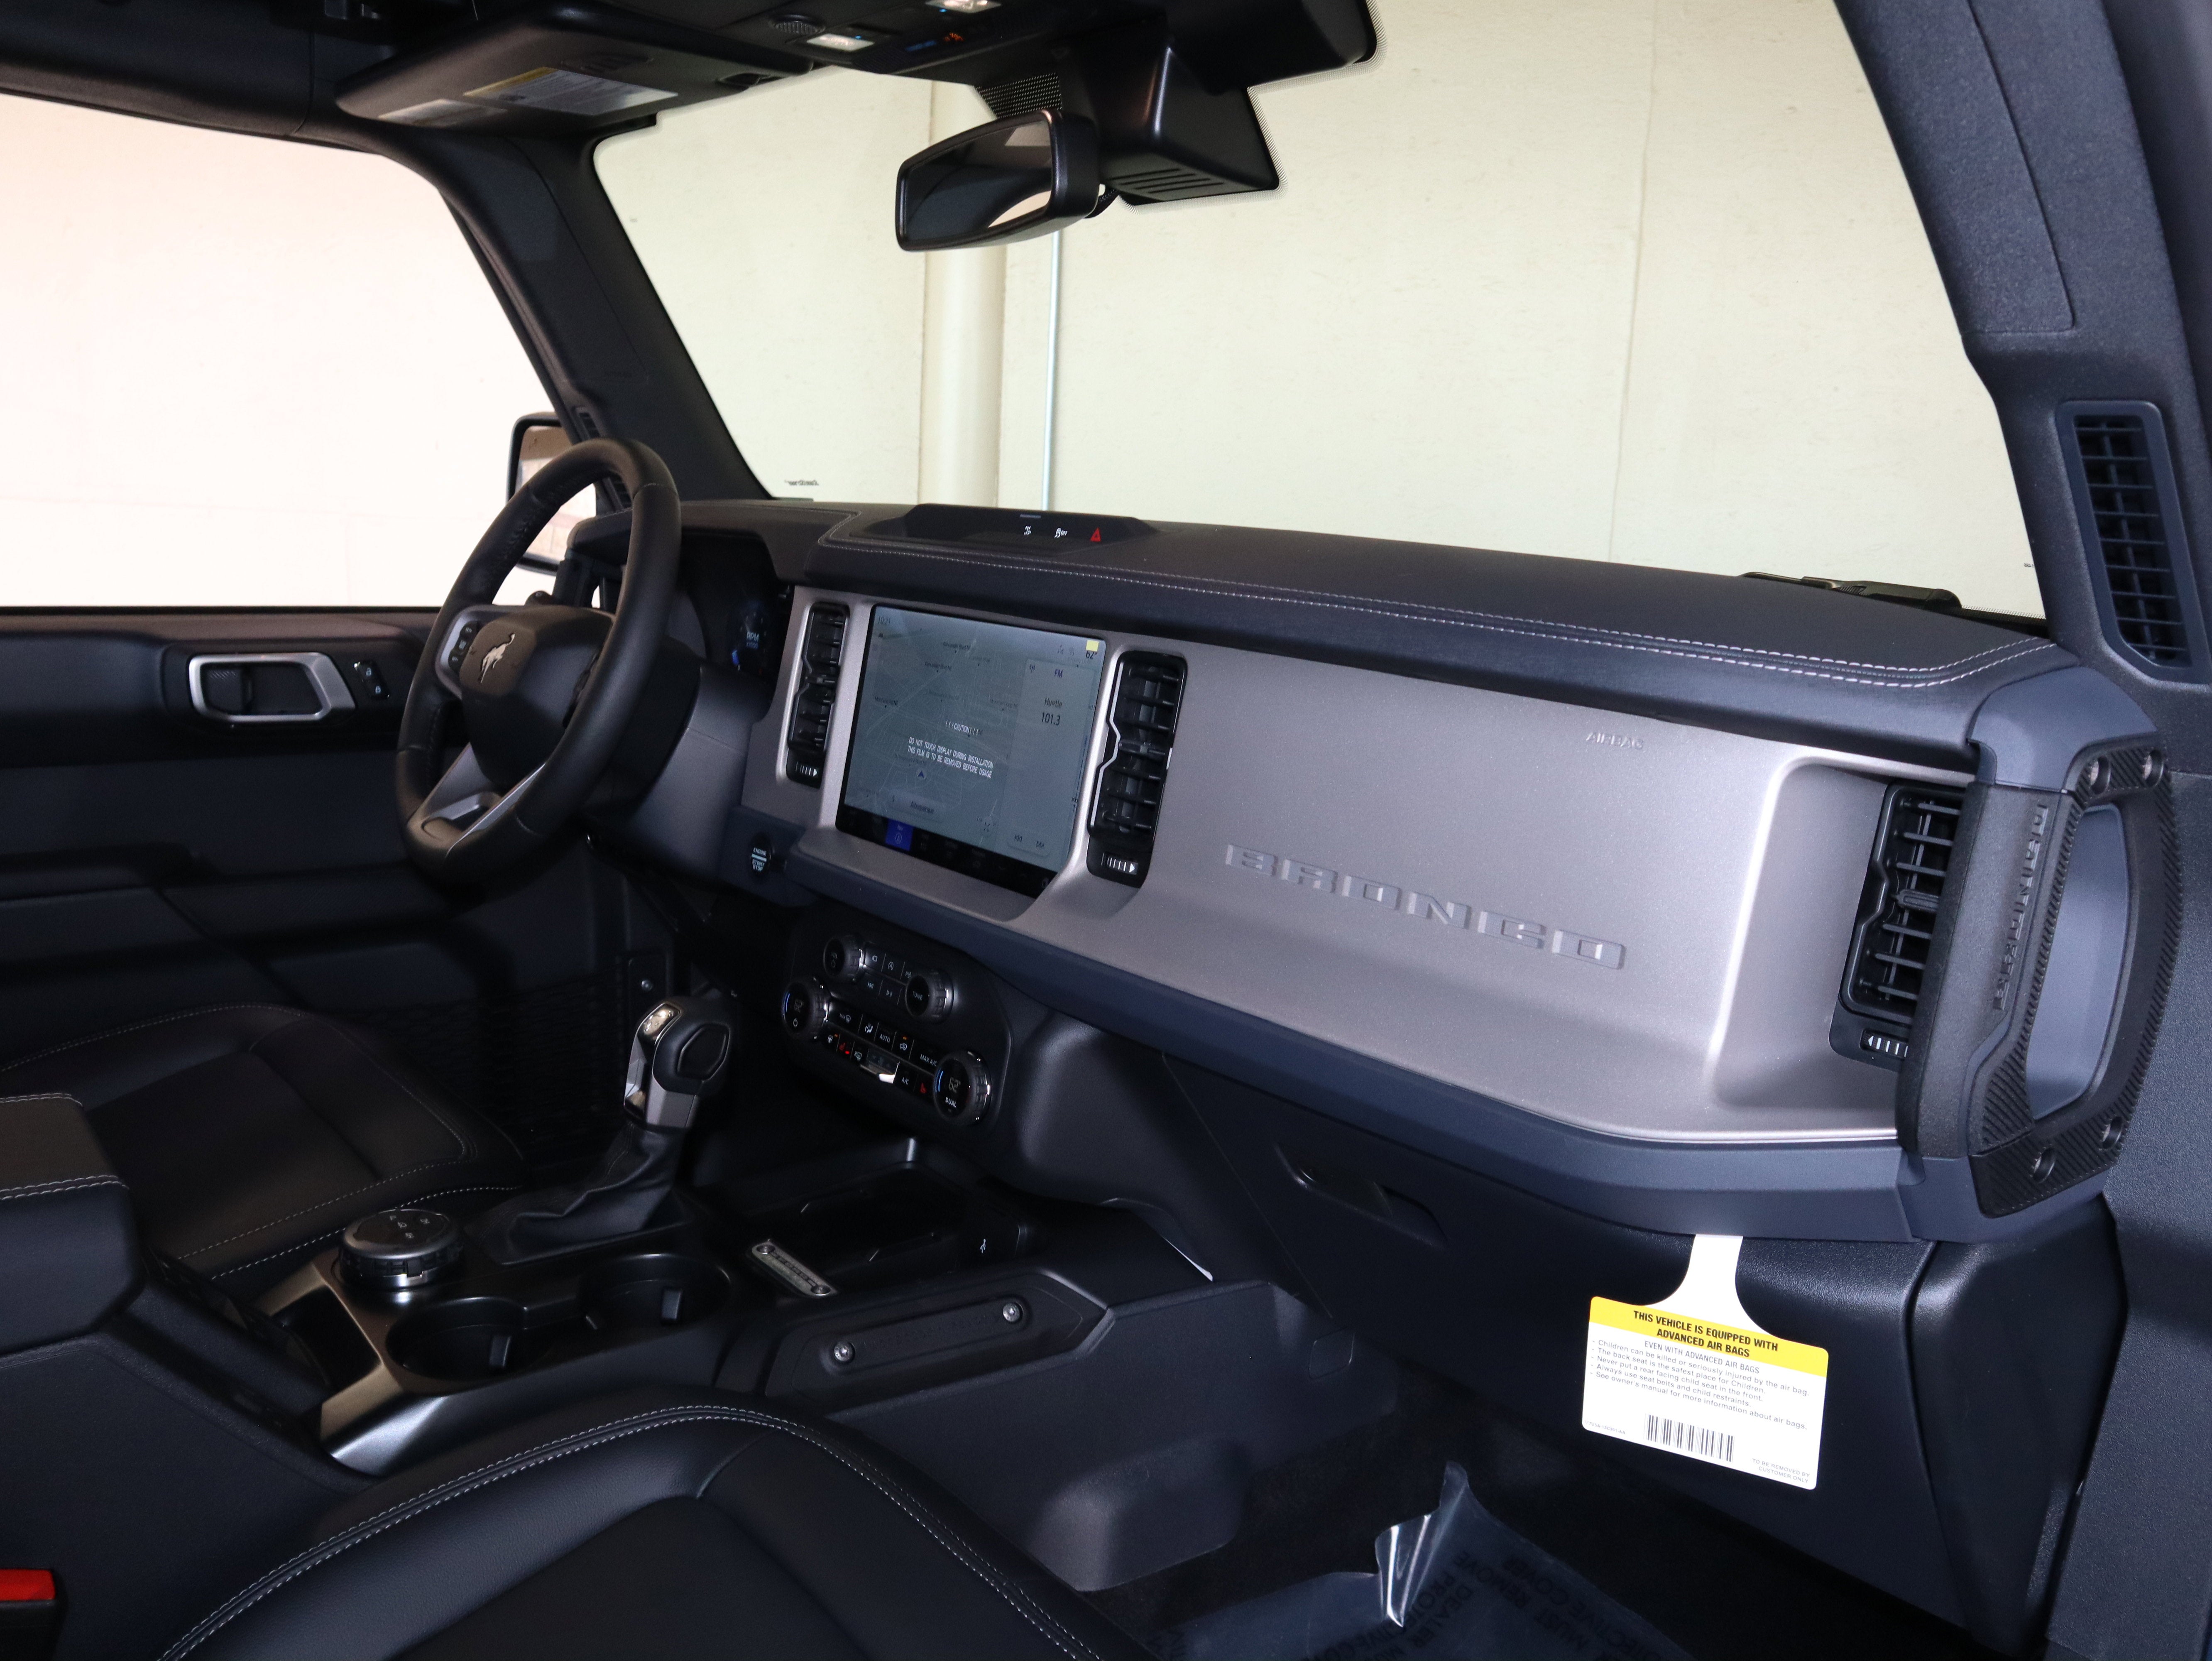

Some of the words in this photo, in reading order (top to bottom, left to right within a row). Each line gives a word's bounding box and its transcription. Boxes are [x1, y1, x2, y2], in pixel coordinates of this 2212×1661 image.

[746, 631, 760, 642] RPM
[1055, 669, 1063, 678] FM
[1041, 712, 1061, 726] 101.3
[916, 748, 925, 757] FILM
[944, 757, 962, 769] REMOVED
[963, 763, 978, 774] BEFORE
[979, 768, 992, 778] USAGE
[924, 741, 936, 751] TOUCH
[937, 745, 952, 756] DISPLAY
[953, 750, 966, 760] DURING
[968, 755, 994, 768] INSTALLATION
[1225, 844, 1626, 970] BRONCO
[912, 991, 923, 1001] TUNE
[879, 1034, 891, 1043] AUTO
[920, 1053, 930, 1063] MAX
[945, 1097, 957, 1108] DUAL
[1634, 1311, 1653, 1322] THIS
[1656, 1316, 1691, 1331] VEHICLE
[1695, 1325, 1703, 1334] IS
[1706, 1328, 1750, 1345] EQUIPPED
[1754, 1338, 1778, 1351] WITH
[1657, 1329, 1704, 1346] ADVANCED
[1707, 1340, 1722, 1350] AIR
[1725, 1345, 1749, 1357] BAGS
[1598, 1340, 1628, 1352] Children
[1657, 1354, 1676, 1364] killed
[1688, 1362, 1723, 1376] seriously
[1725, 1370, 1752, 1382] injured
[1754, 1377, 1764, 1386] by
[1766, 1380, 1778, 1388] the
[1792, 1386, 1809, 1396] bag.
[1598, 1347, 1611, 1356] The
[1613, 1351, 1630, 1361] back
[1671, 1367, 1694, 1376] safest
[1696, 1372, 1716, 1382] place
[1731, 1380, 1765, 1394] Children.
[1644, 1340, 1662, 1351] EVEN
[1665, 1345, 1683, 1355] WITH
[1685, 1350, 1723, 1365] ADVANCED
[1725, 1360, 1737, 1369] AIR
[1740, 1363, 1759, 1374] BAGS
[1596, 1364, 1622, 1375] Always
[1657, 1378, 1674, 1388] belts
[1693, 1388, 1711, 1397] child
[1713, 1393, 1751, 1407] restraints.
[1597, 1355, 1618, 1365] Never
[1656, 1370, 1679, 1382] facing
[1681, 1377, 1699, 1386] child
[1701, 1382, 1717, 1390] seat
[1743, 1391, 1763, 1401] front.
[1596, 1371, 1609, 1379] See
[1611, 1376, 1639, 1387] owner's
[1641, 1384, 1668, 1394] manual
[1683, 1394, 1702, 1403] more
[1704, 1398, 1747, 1414] information
[1750, 1411, 1772, 1421] about
[1786, 1419, 1807, 1430] bags.
[1758, 1466, 1791, 1479] CUSTOMER
[1771, 1463, 1801, 1475] REMOVED
